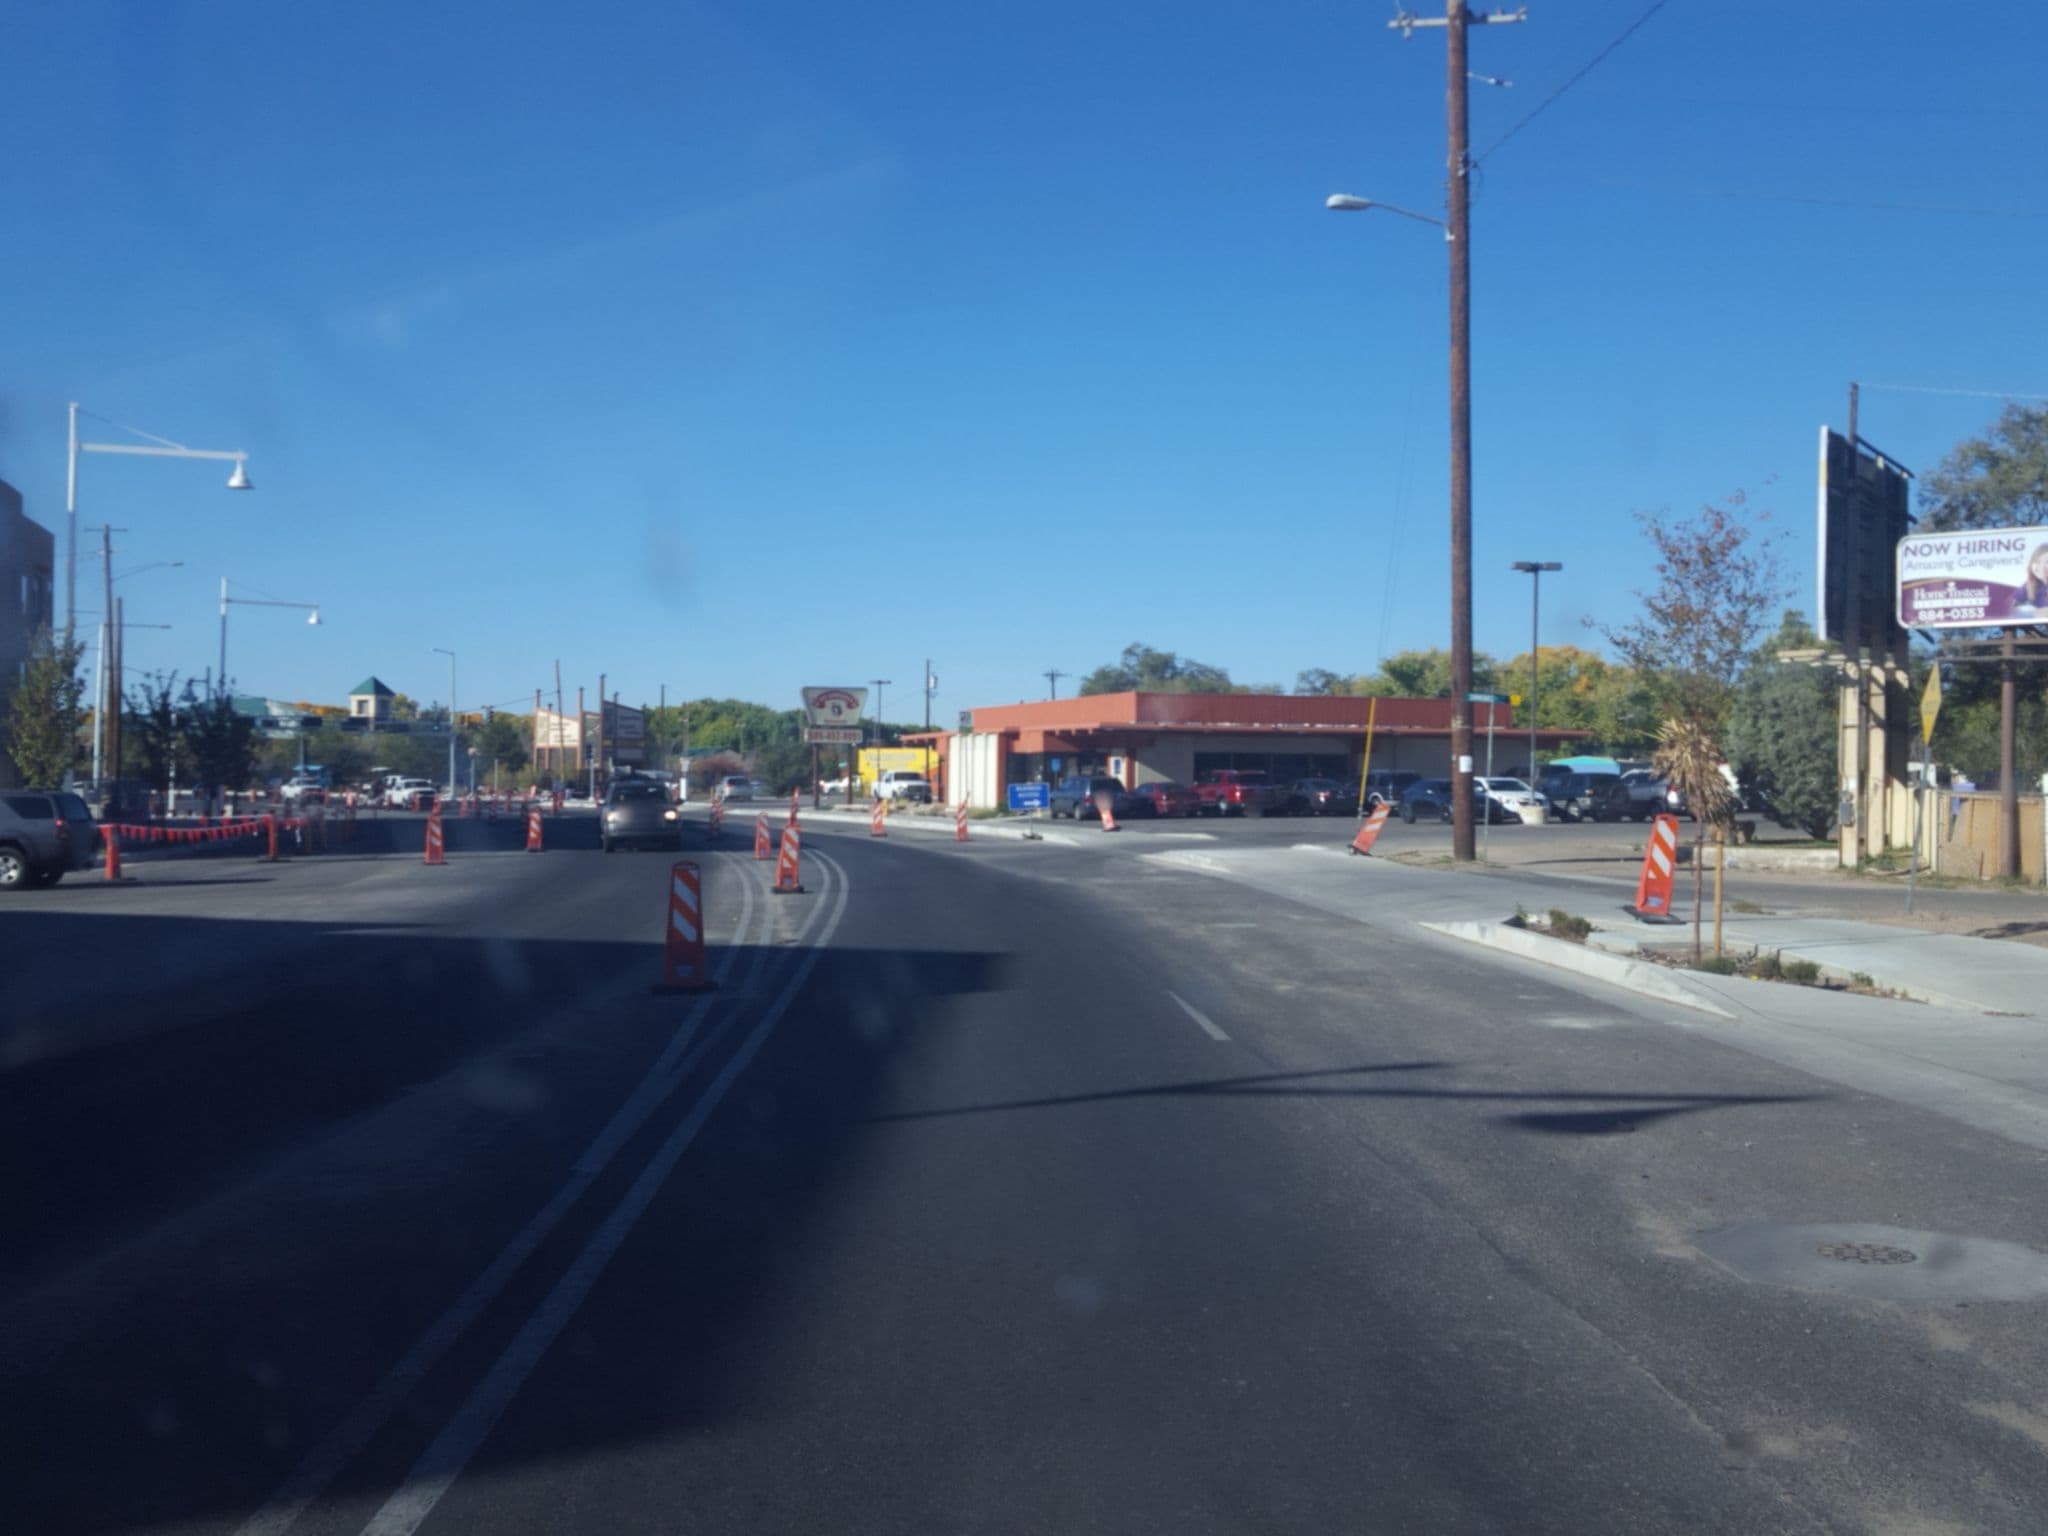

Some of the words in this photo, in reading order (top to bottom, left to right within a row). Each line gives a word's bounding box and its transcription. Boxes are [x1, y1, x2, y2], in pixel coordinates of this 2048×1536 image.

[1904, 543, 1951, 557] NOW
[1958, 538, 2025, 554] HIRING
[1906, 560, 1954, 571] Amazing
[1914, 588, 1947, 600] Home
